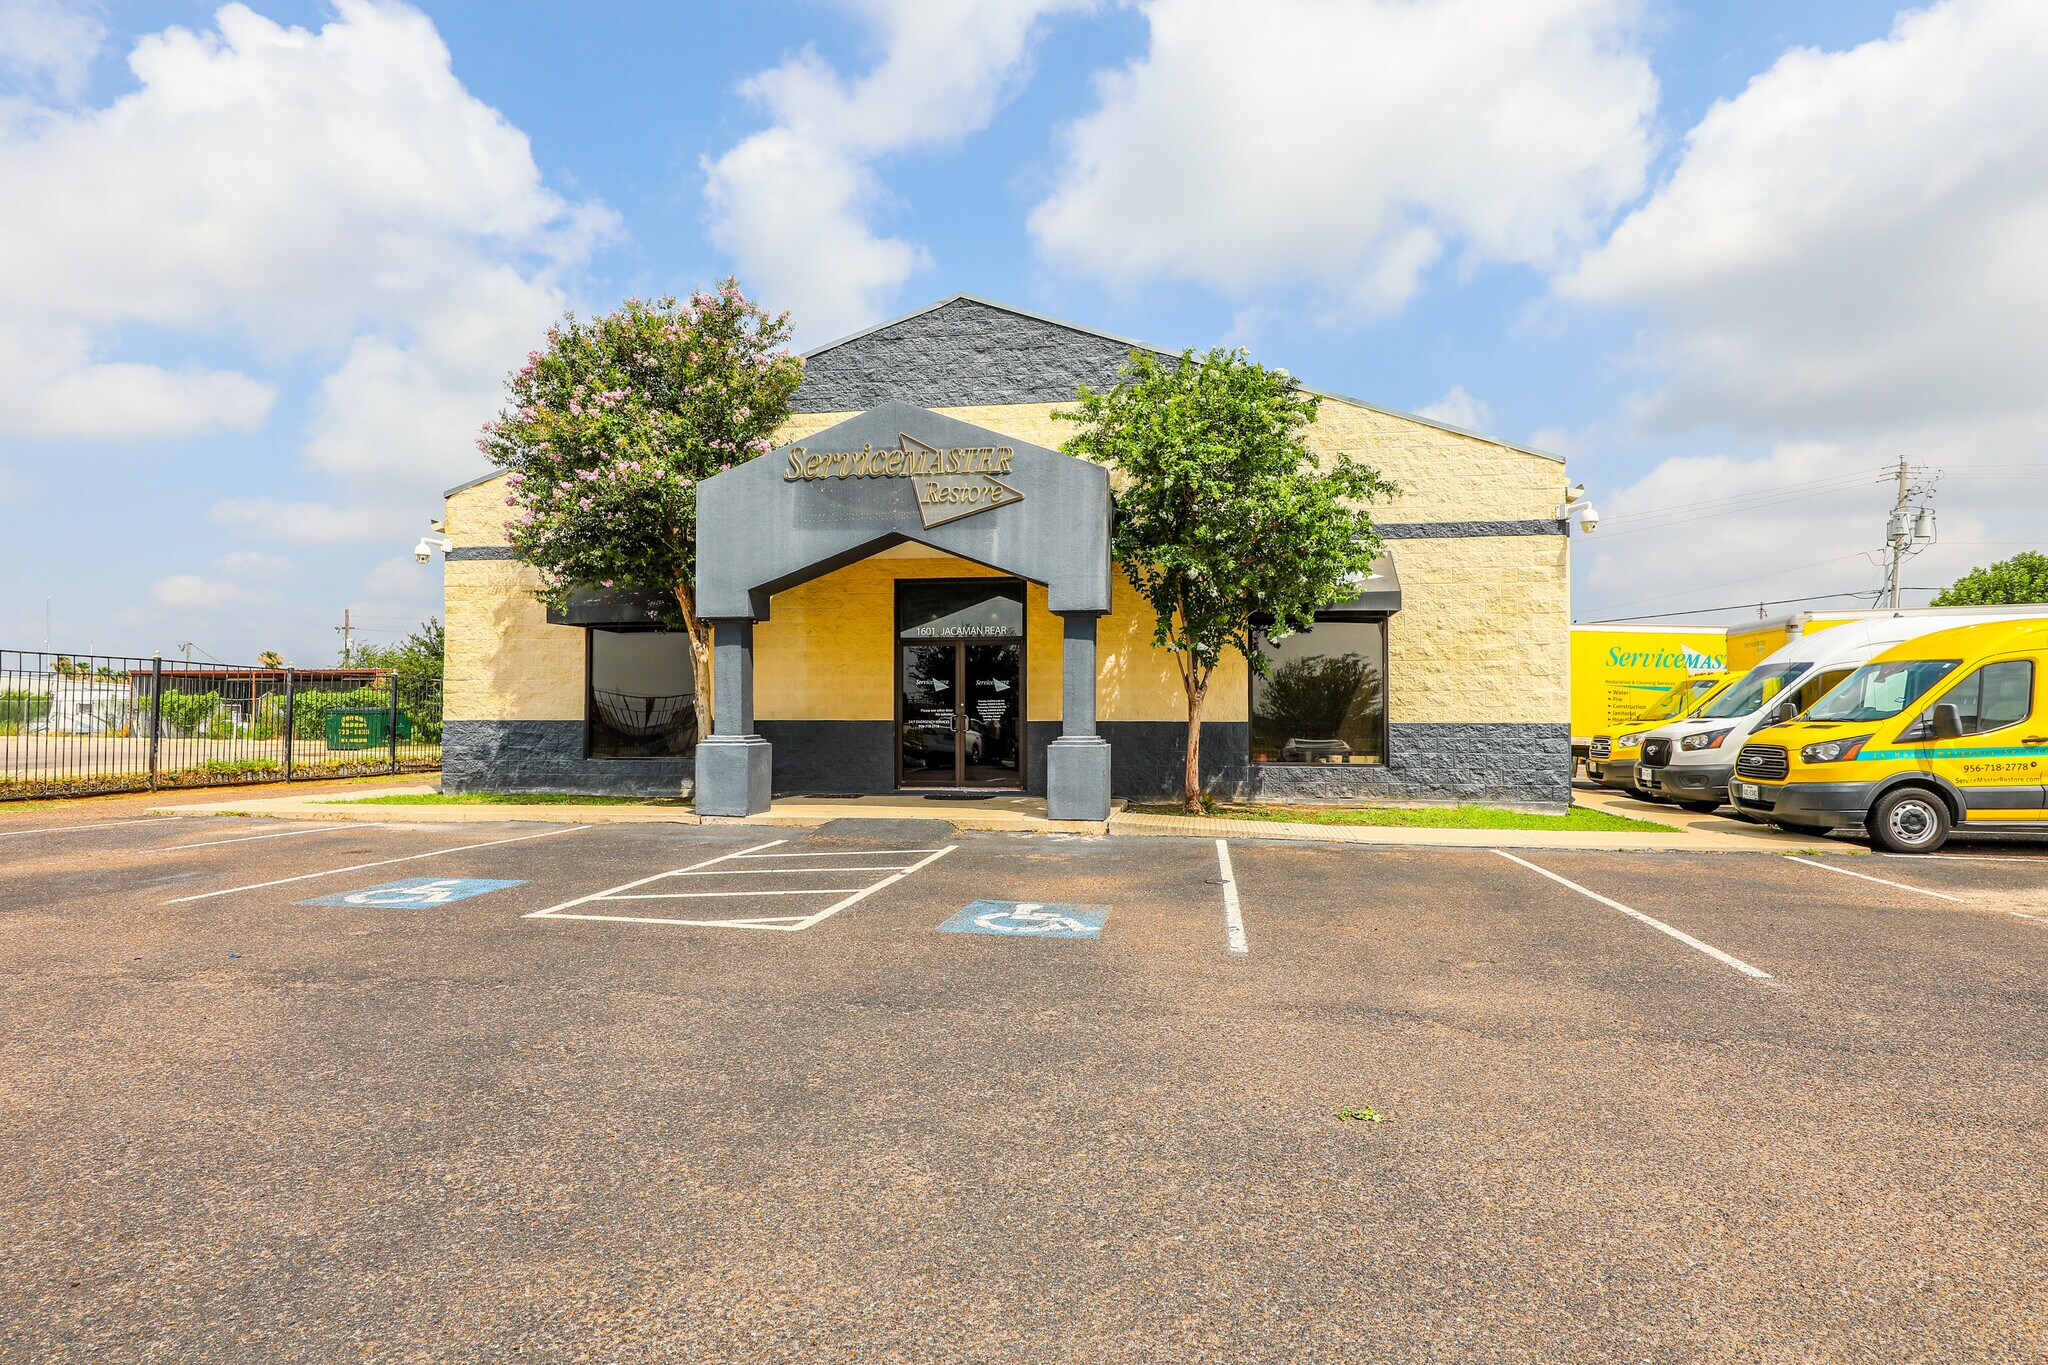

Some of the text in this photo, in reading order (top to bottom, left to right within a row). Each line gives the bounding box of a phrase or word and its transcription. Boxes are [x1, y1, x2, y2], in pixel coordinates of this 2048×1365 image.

[784, 442, 1014, 480] ServiceMASTER
[921, 481, 1004, 505] Restore
[917, 626, 1007, 636] 1601 JACAMAN REAR
[1963, 763, 2028, 772] 956-718-2778
[1955, 776, 2039, 784] ServiceMasterRestore.com
